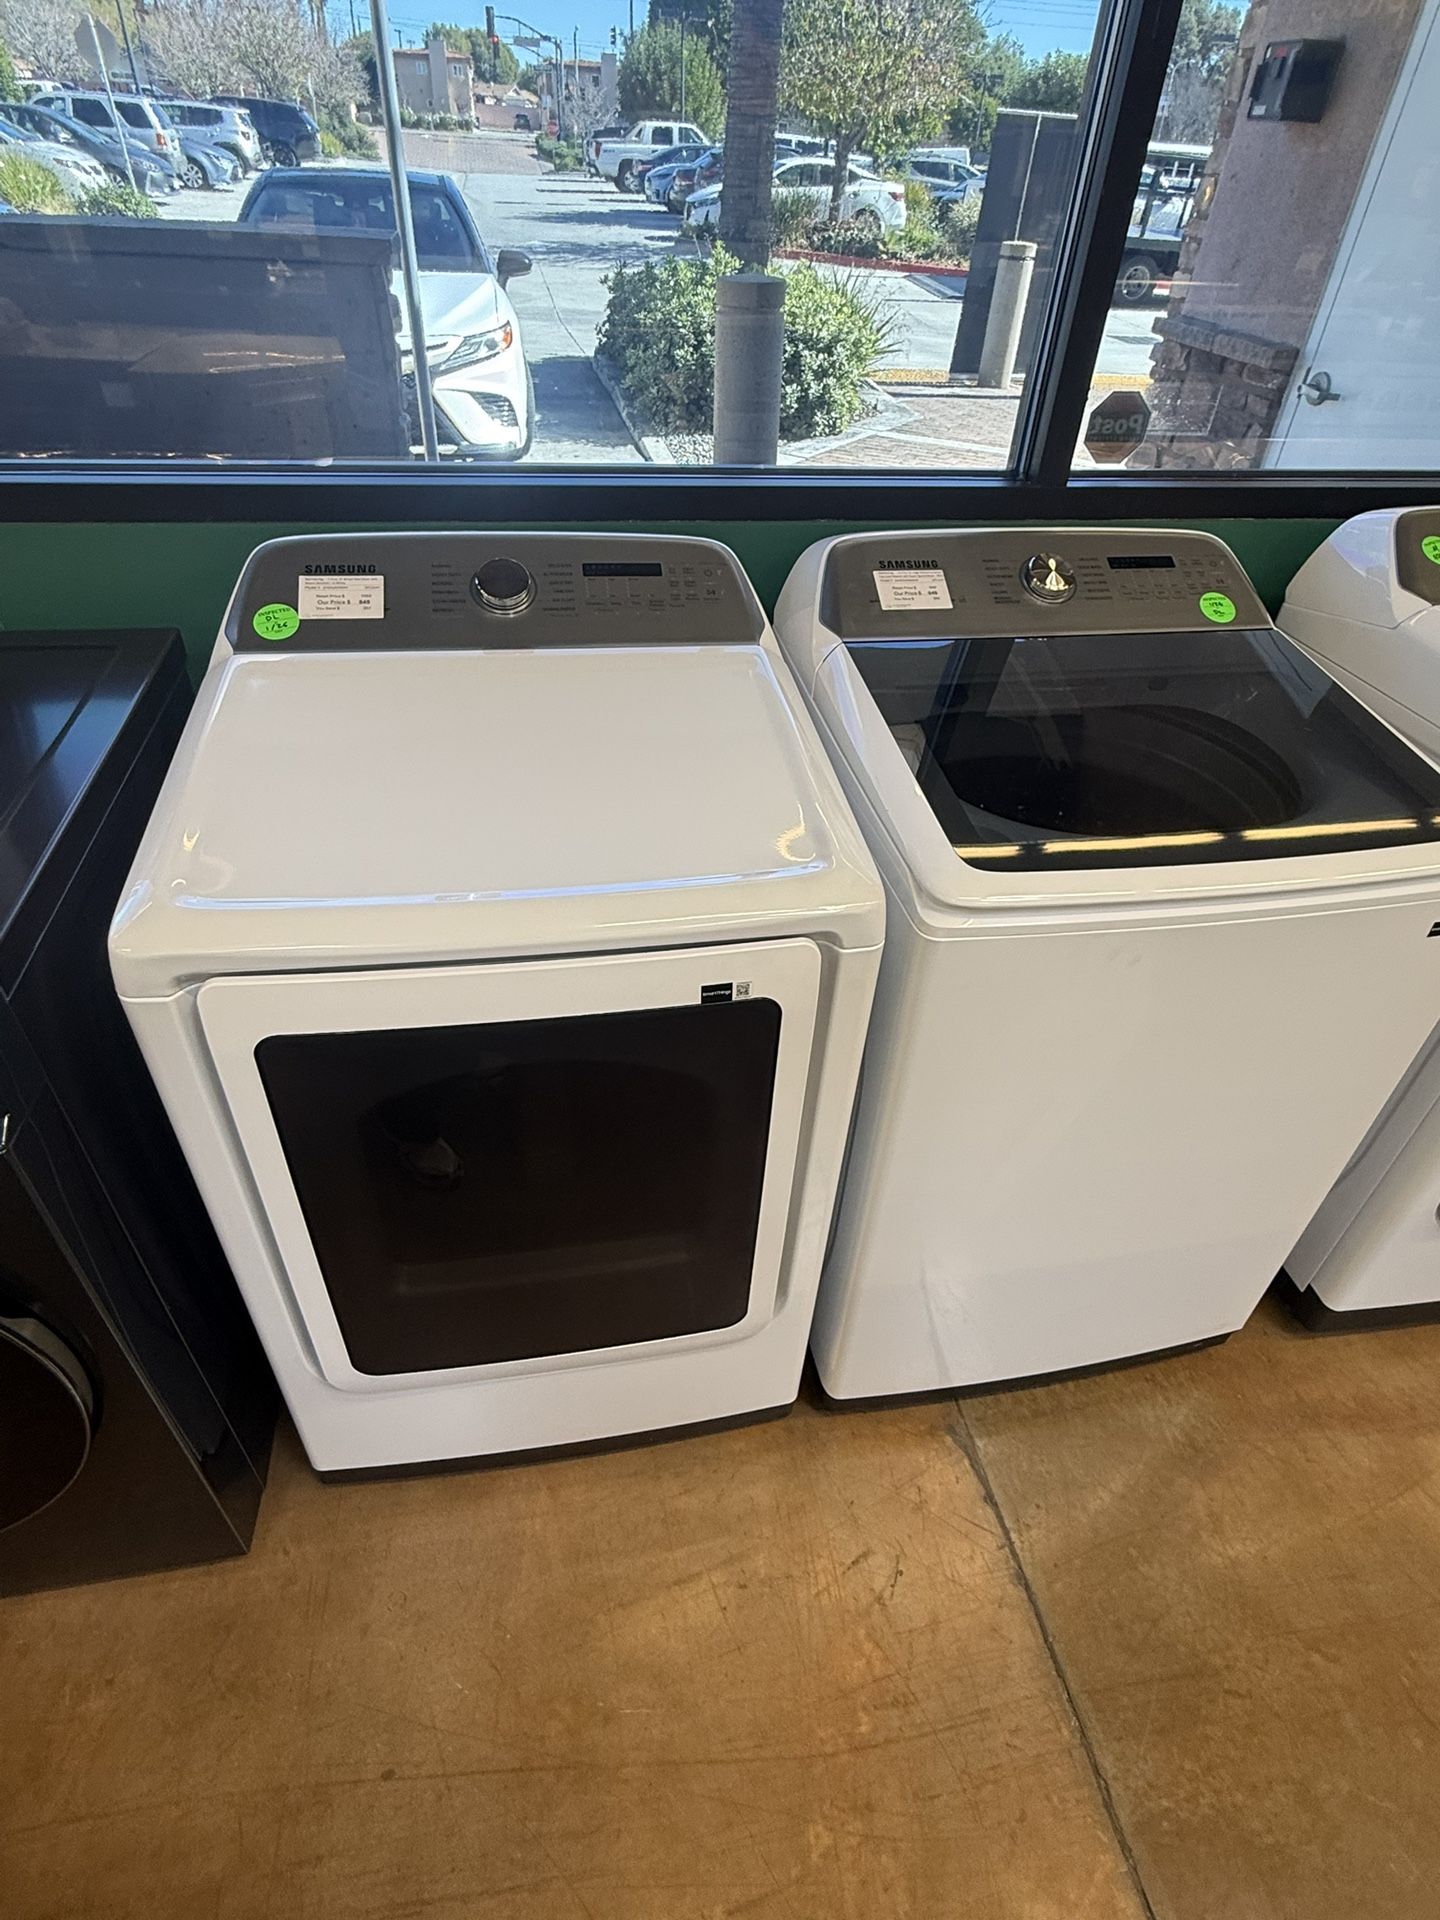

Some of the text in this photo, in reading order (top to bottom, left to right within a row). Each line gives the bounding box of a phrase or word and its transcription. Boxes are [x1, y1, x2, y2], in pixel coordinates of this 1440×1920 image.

[305, 564, 376, 573] SAMSUNG
[879, 560, 938, 569] SAMSUNG
[258, 608, 291, 617] INSPECTED
